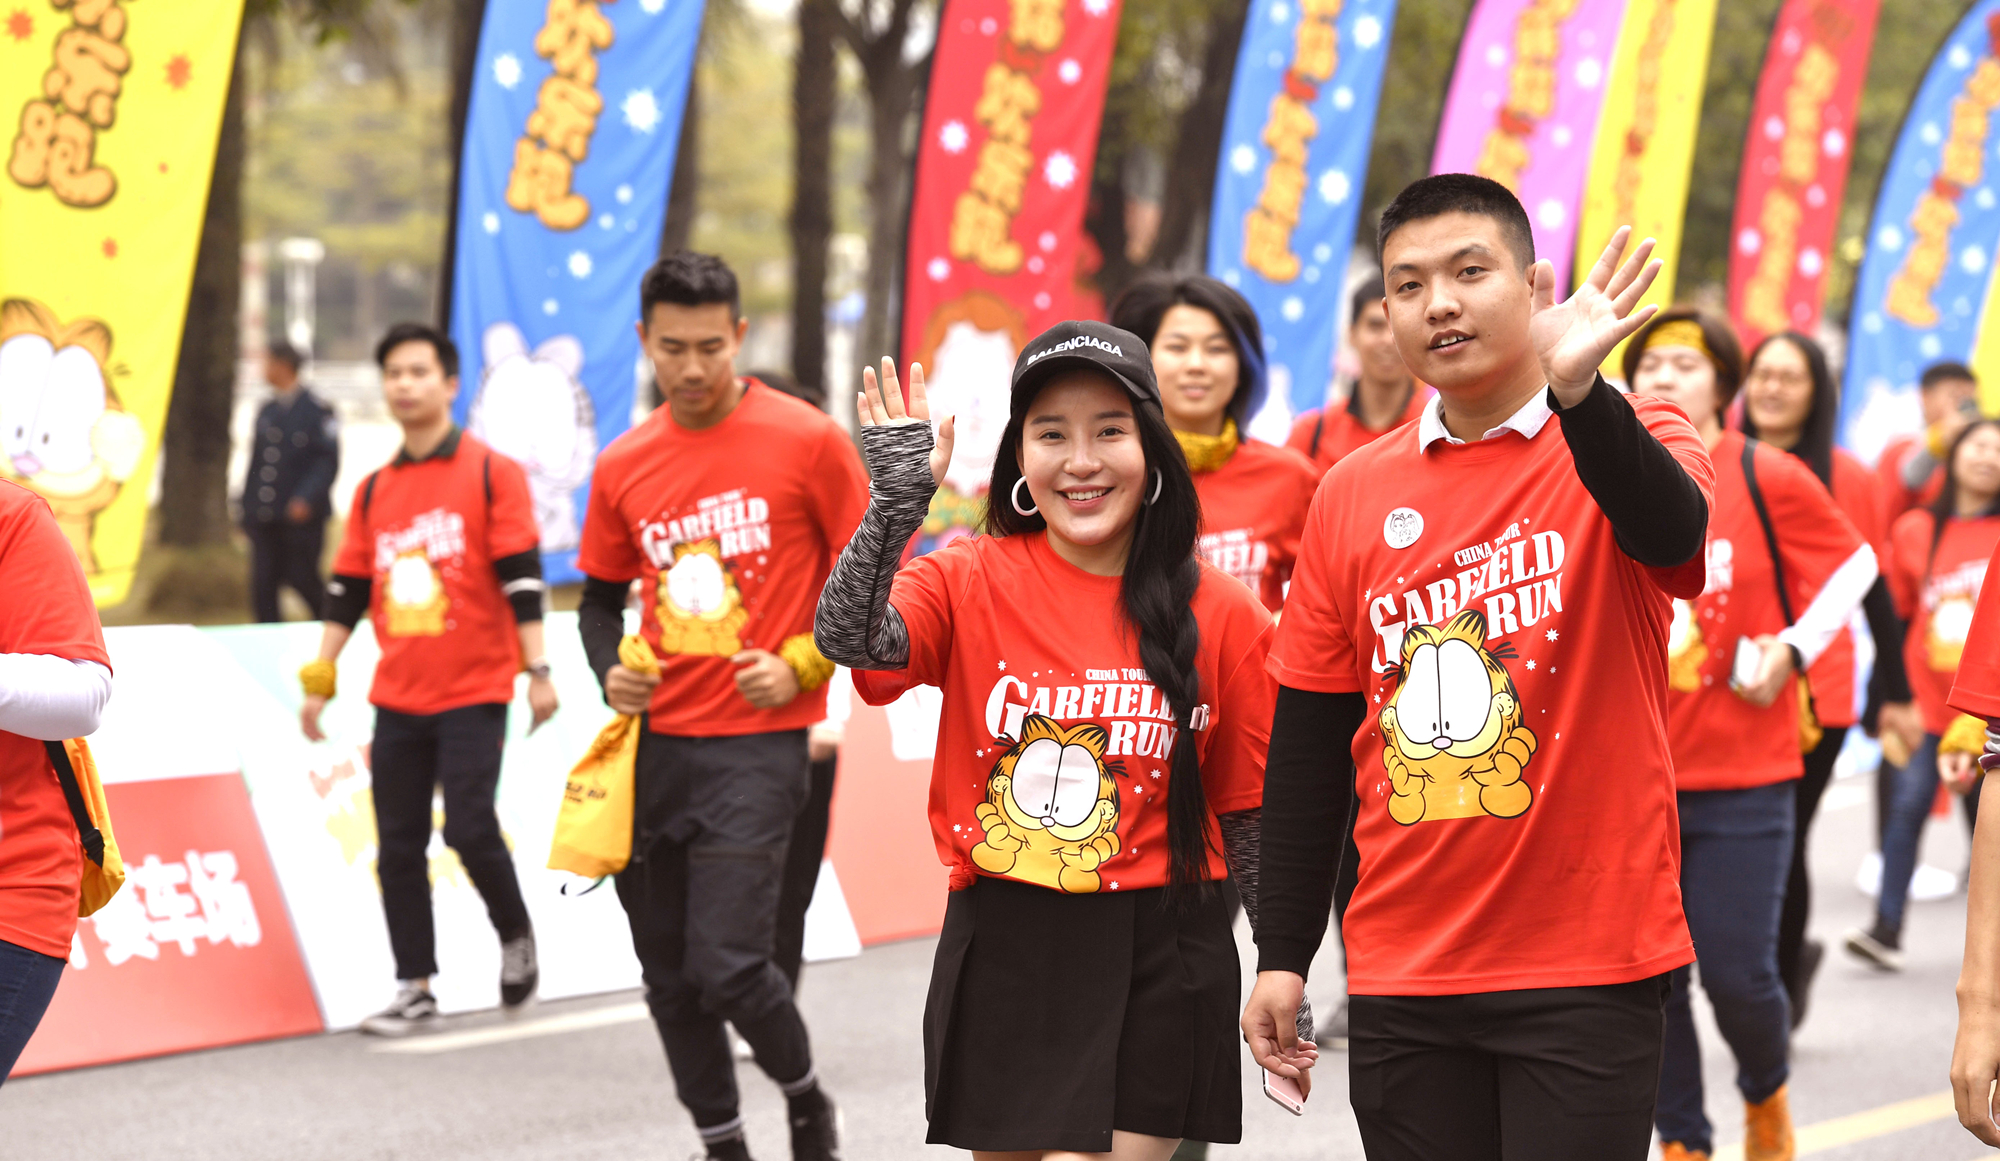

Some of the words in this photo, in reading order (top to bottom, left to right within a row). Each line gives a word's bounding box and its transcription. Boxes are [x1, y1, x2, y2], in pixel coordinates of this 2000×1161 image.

[1027, 335, 1123, 366] BALENCIAGA
[640, 496, 770, 570] GARFIELD
[720, 522, 772, 560] RUN
[1453, 541, 1494, 568] CHINA
[1369, 530, 1565, 674] GARFIELD
[1484, 572, 1564, 641] RUN
[1085, 668, 1119, 681] CHINA
[1105, 720, 1178, 761] RUN
